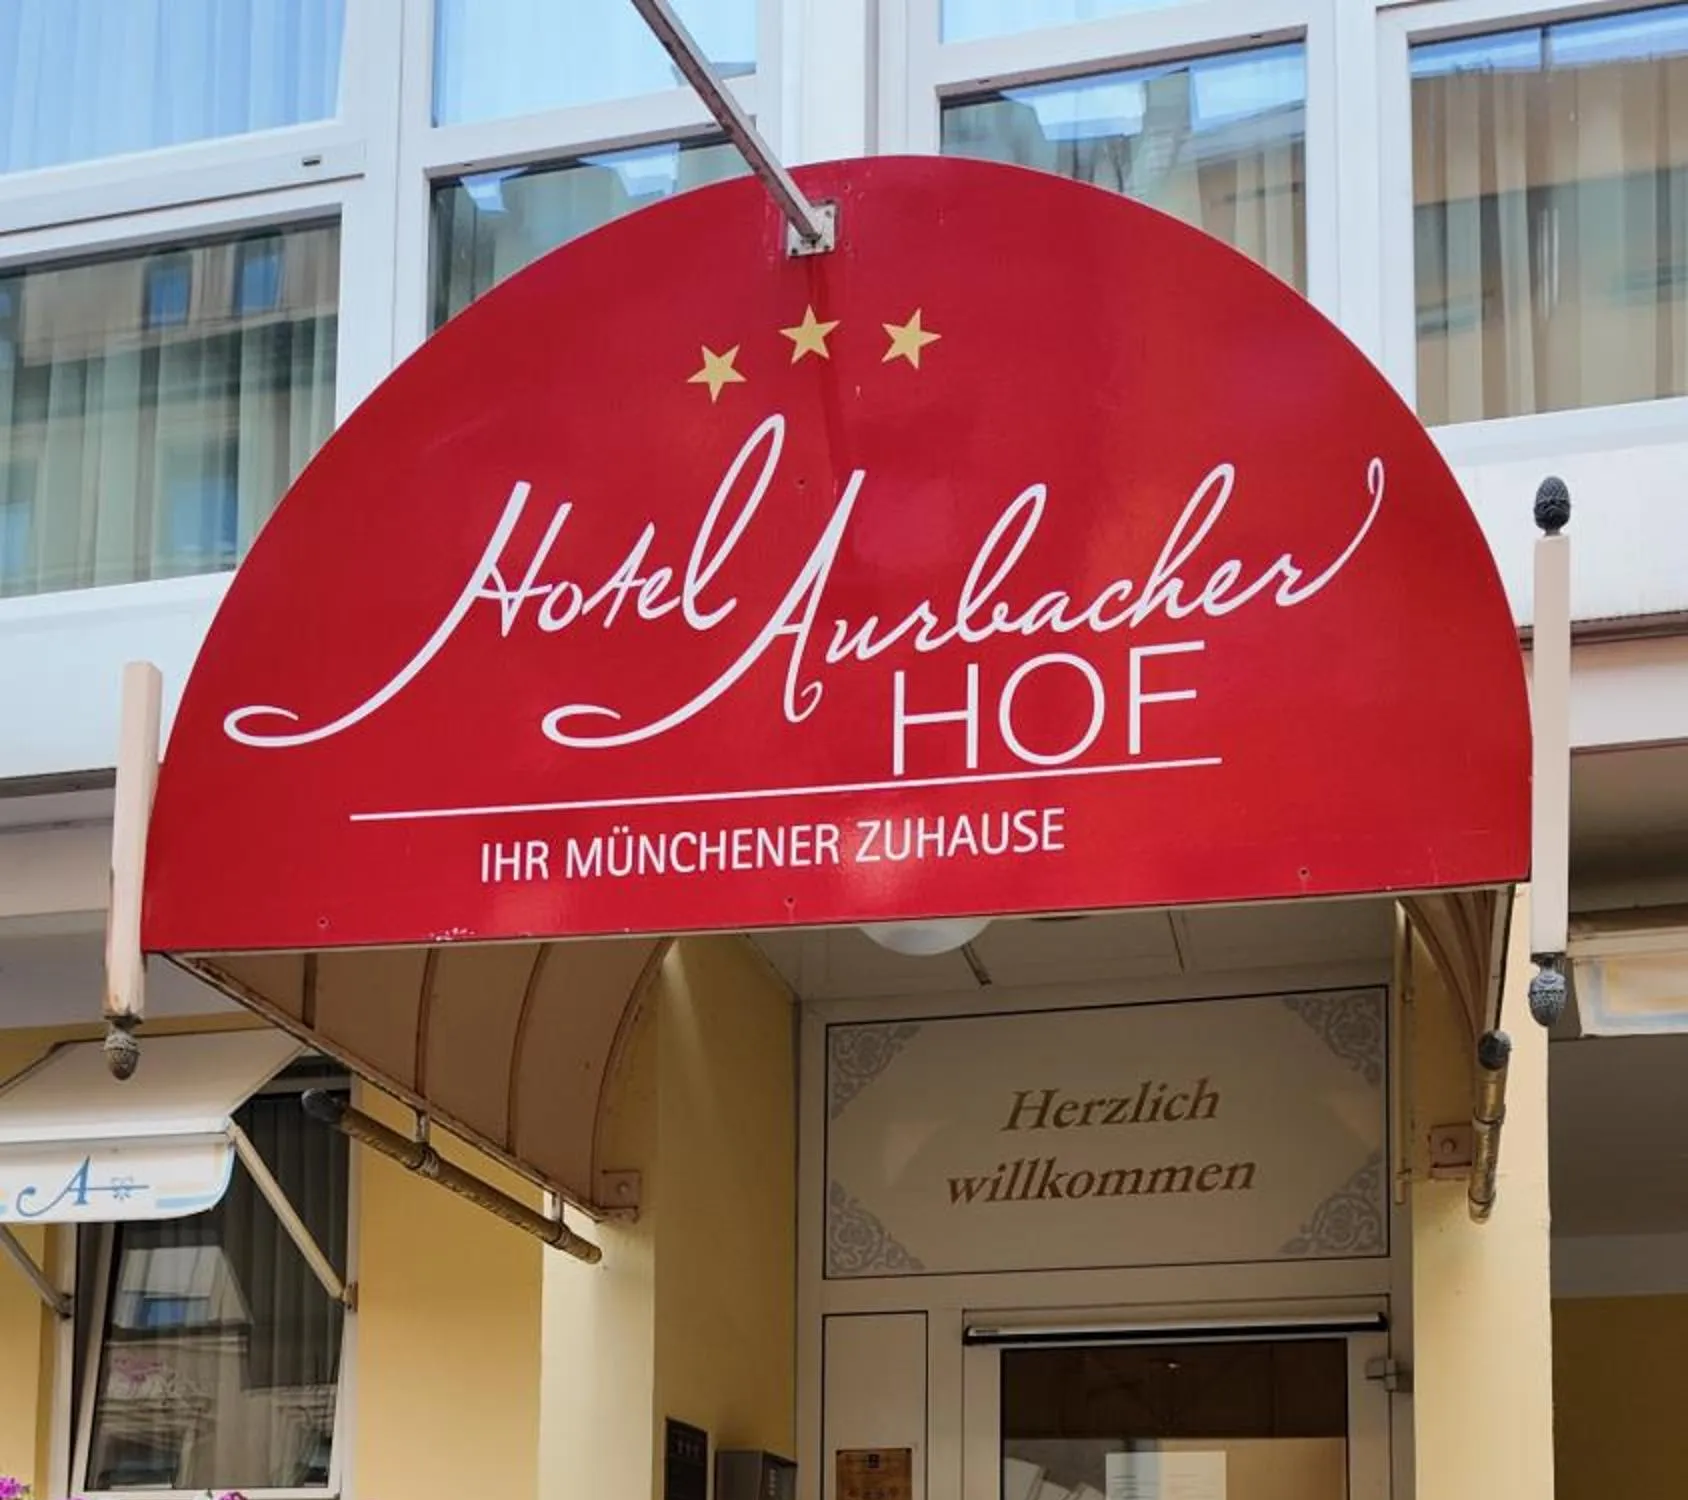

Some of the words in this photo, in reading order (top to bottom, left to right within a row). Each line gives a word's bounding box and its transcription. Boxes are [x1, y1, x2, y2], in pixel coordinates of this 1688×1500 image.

[224, 414, 786, 748] Hotel
[542, 458, 1385, 748] Aurbacher
[893, 639, 1205, 776] HOF
[481, 840, 549, 883] IHR
[566, 823, 840, 879] MÜNCHENER
[854, 807, 1066, 864] ZUHAUSE
[1001, 1077, 1220, 1131] Herzlich
[948, 1156, 1256, 1204] willkommen
